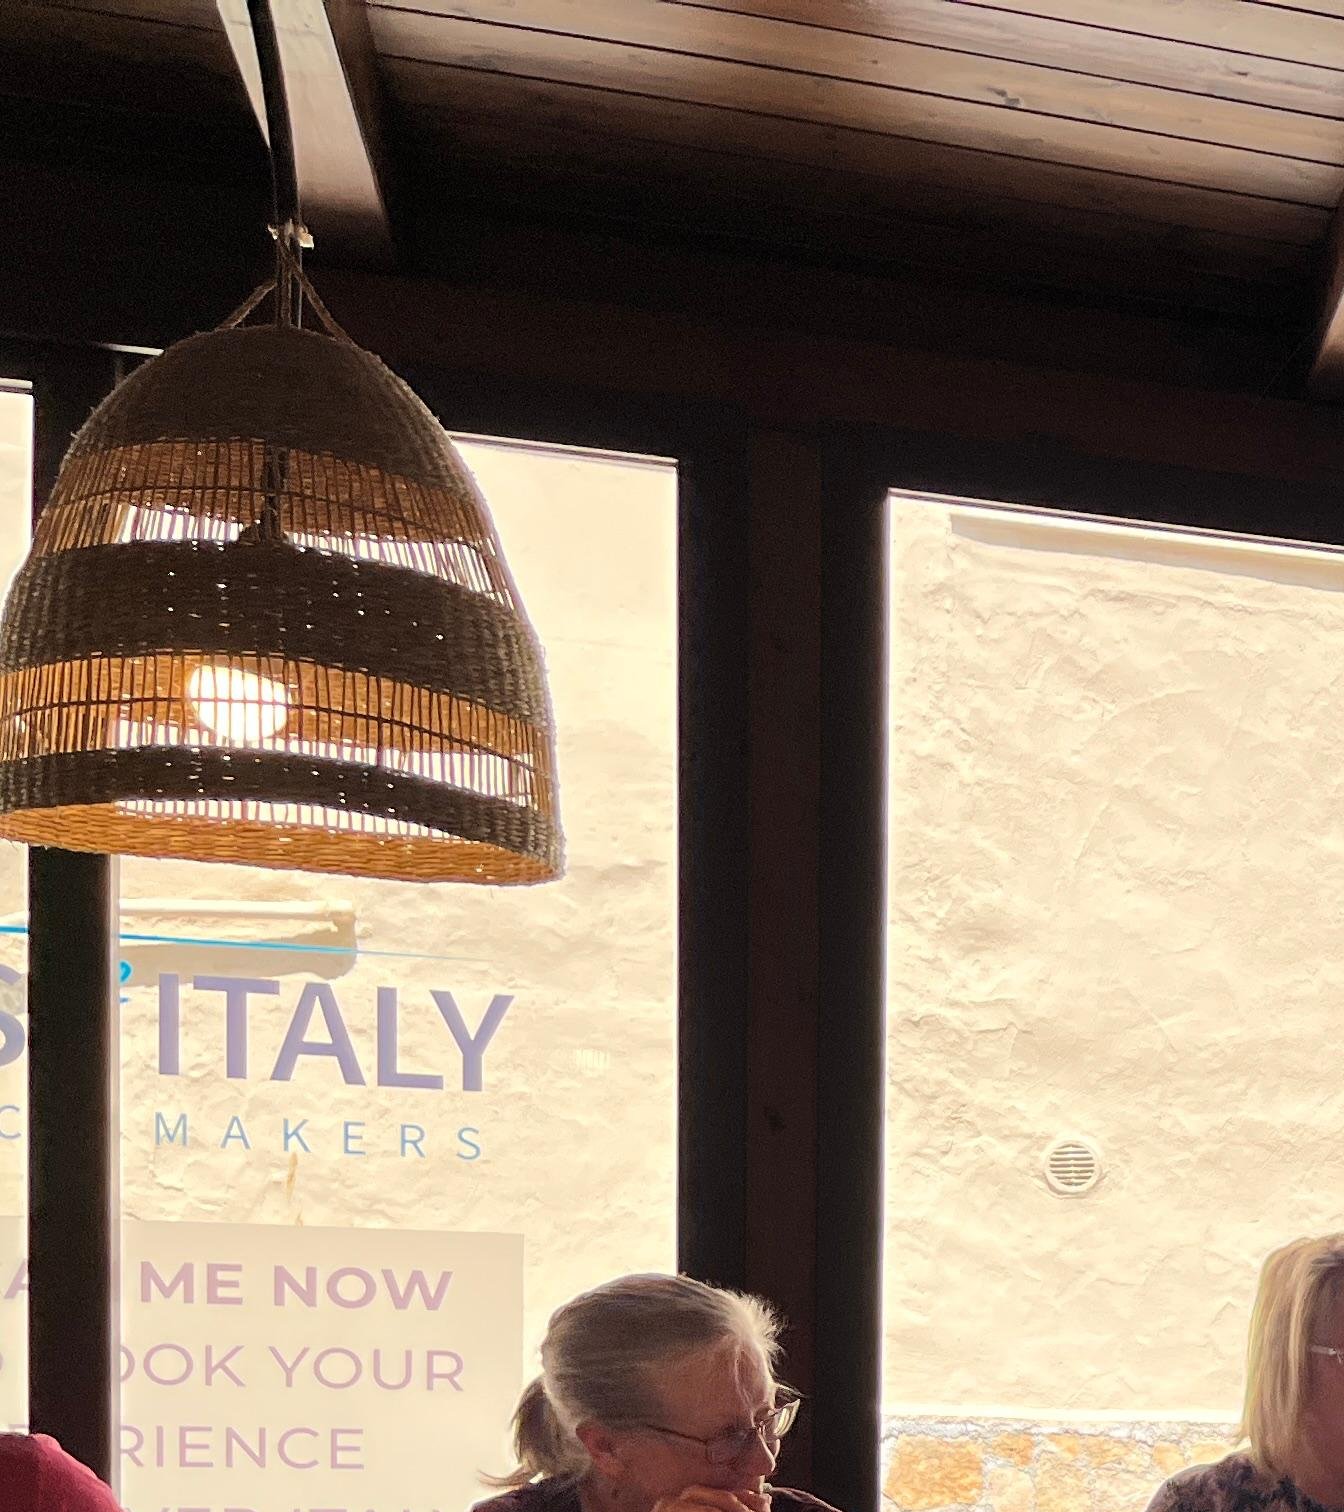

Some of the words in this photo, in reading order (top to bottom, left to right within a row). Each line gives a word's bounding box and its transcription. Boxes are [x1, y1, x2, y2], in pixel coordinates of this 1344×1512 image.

[158, 973, 515, 1092] ITALY
[154, 1111, 482, 1160] MAKERS
[140, 1261, 243, 1305] ME
[274, 1265, 453, 1311] NOW
[121, 1343, 246, 1388] OK
[268, 1346, 464, 1392] YOUR
[121, 1425, 364, 1470] RIENCE
